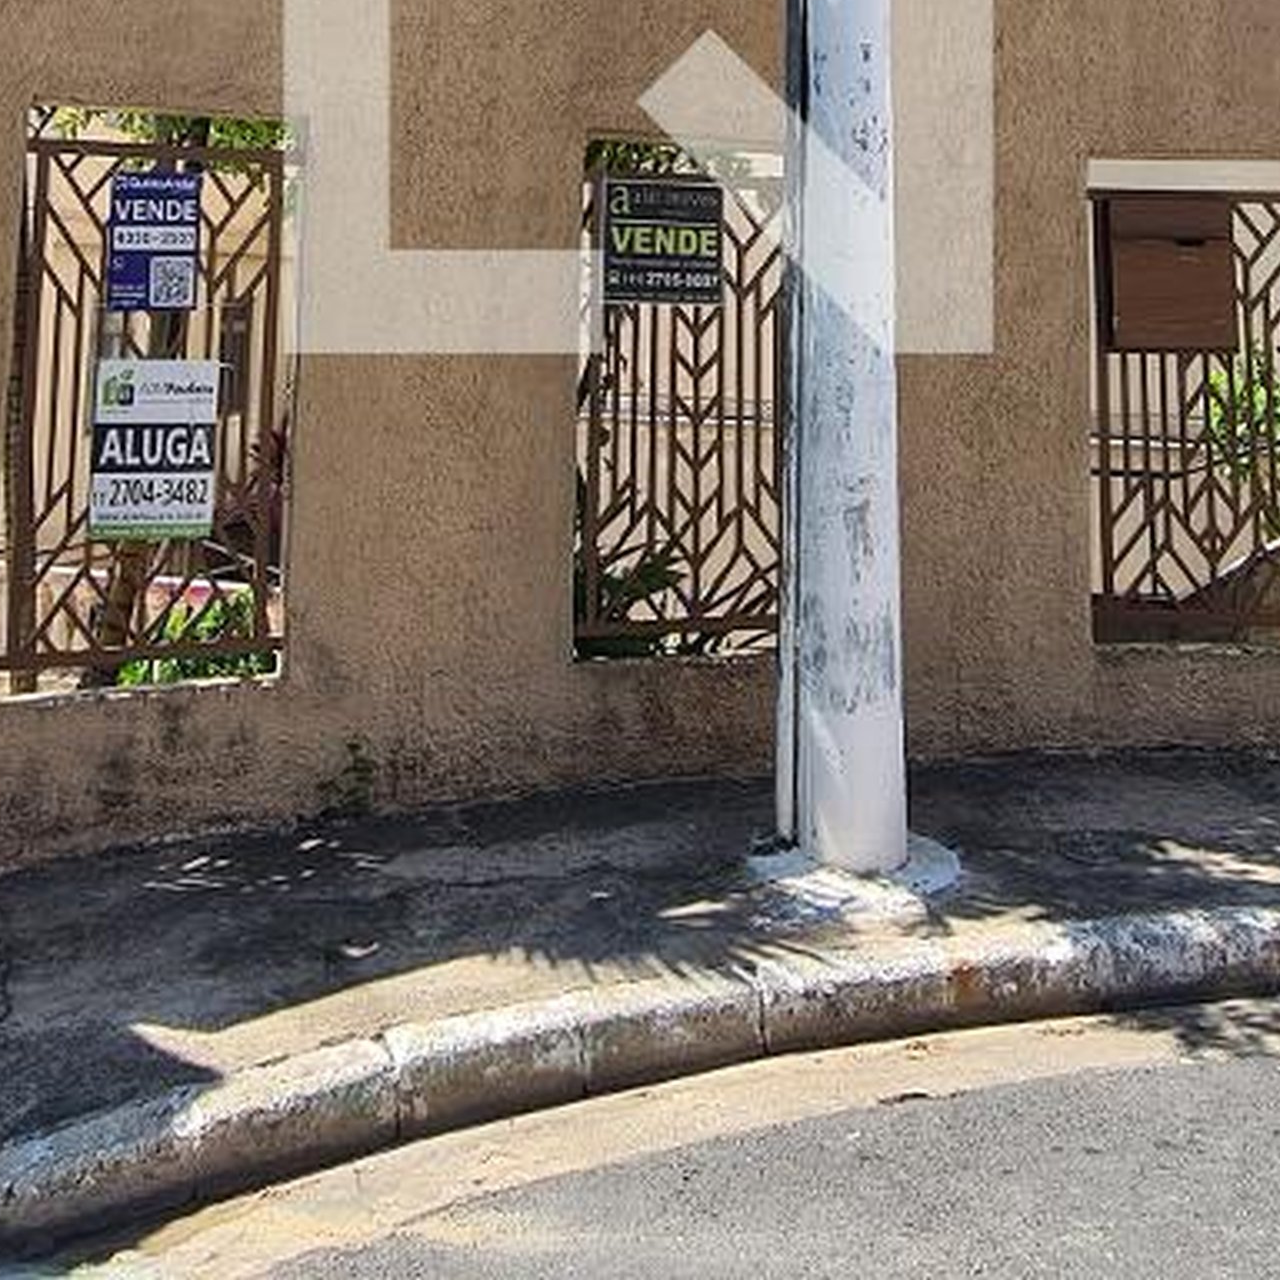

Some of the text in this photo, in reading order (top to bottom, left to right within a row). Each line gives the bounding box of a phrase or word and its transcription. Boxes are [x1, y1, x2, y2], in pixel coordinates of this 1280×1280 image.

[114, 199, 198, 221] VENDE
[611, 226, 718, 257] VENDE
[99, 427, 212, 466] ALUGA
[109, 478, 208, 507] 2704-3482
